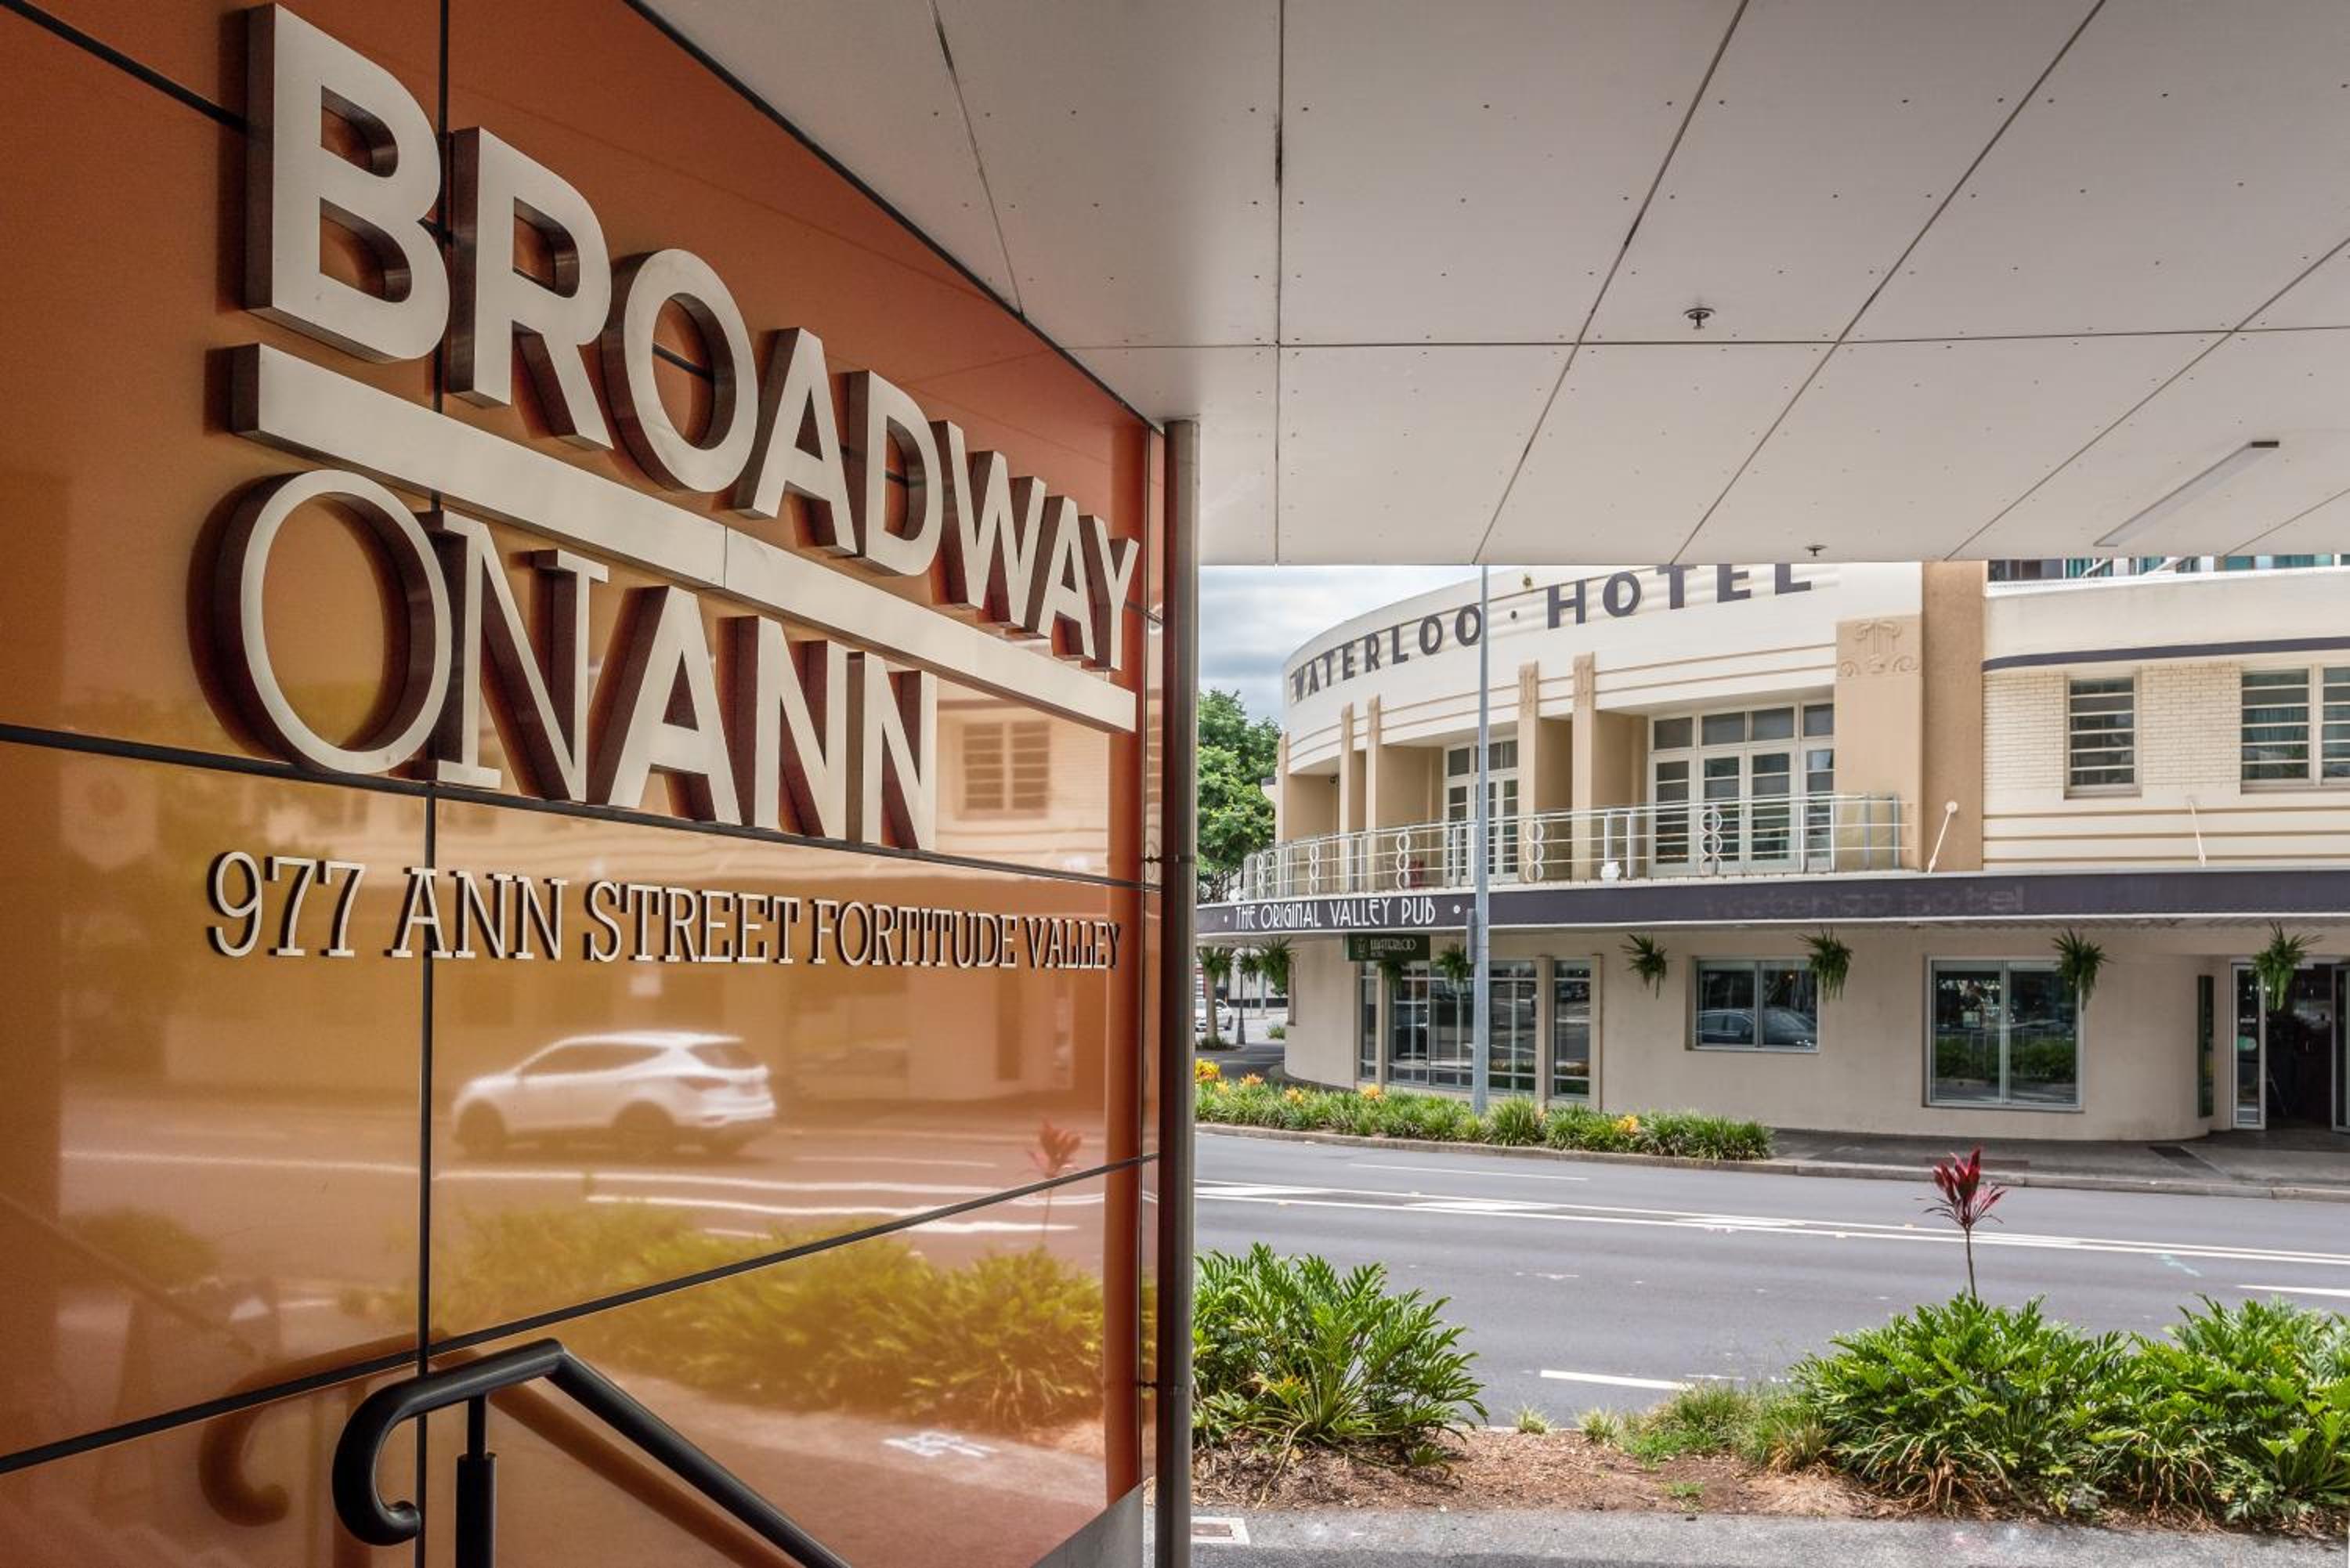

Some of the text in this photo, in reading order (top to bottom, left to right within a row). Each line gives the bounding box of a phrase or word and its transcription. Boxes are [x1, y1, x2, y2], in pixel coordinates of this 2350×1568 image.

[270, 3, 1140, 671] BROADWAY
[1296, 564, 1812, 703] WATERLOO HOTEL
[212, 851, 1121, 970] 977 ANN STREET FORTITUDE VALLEY
[1235, 896, 1437, 930] THE ORIGINAL VALLEY PUB
